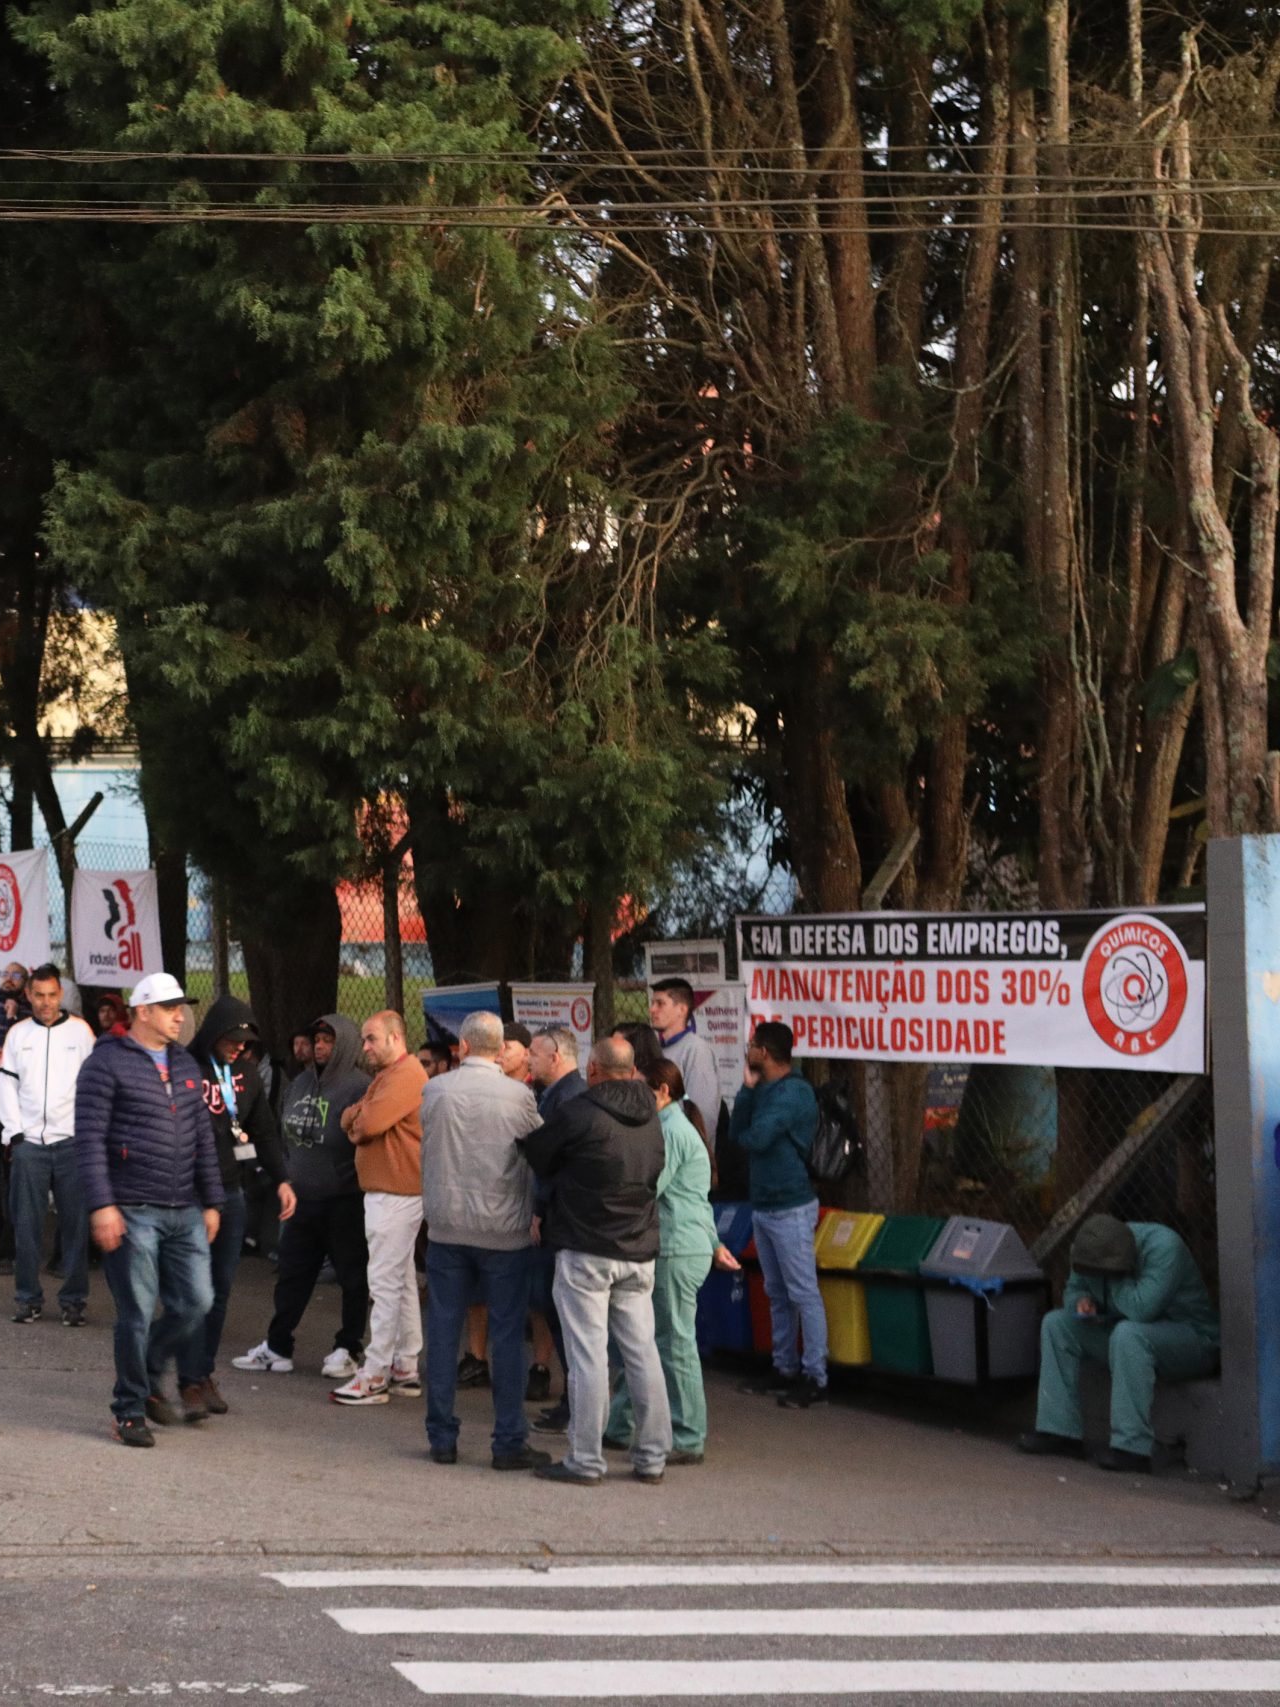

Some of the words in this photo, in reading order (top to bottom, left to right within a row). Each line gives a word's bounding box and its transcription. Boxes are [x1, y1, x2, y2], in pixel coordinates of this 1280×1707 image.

[751, 925, 782, 955] EM
[789, 924, 866, 956] DEFESA
[873, 923, 919, 955] DOS
[926, 920, 1068, 960] EMPREGOS,
[1100, 925, 1168, 959] QUÍMICOS
[751, 959, 925, 1014] MANUTENÇÃO
[936, 969, 990, 1004] DOS
[1001, 968, 1071, 1006] 30%
[792, 1014, 1007, 1055] PERICULOSIDADE
[1114, 1031, 1156, 1053] ABC
